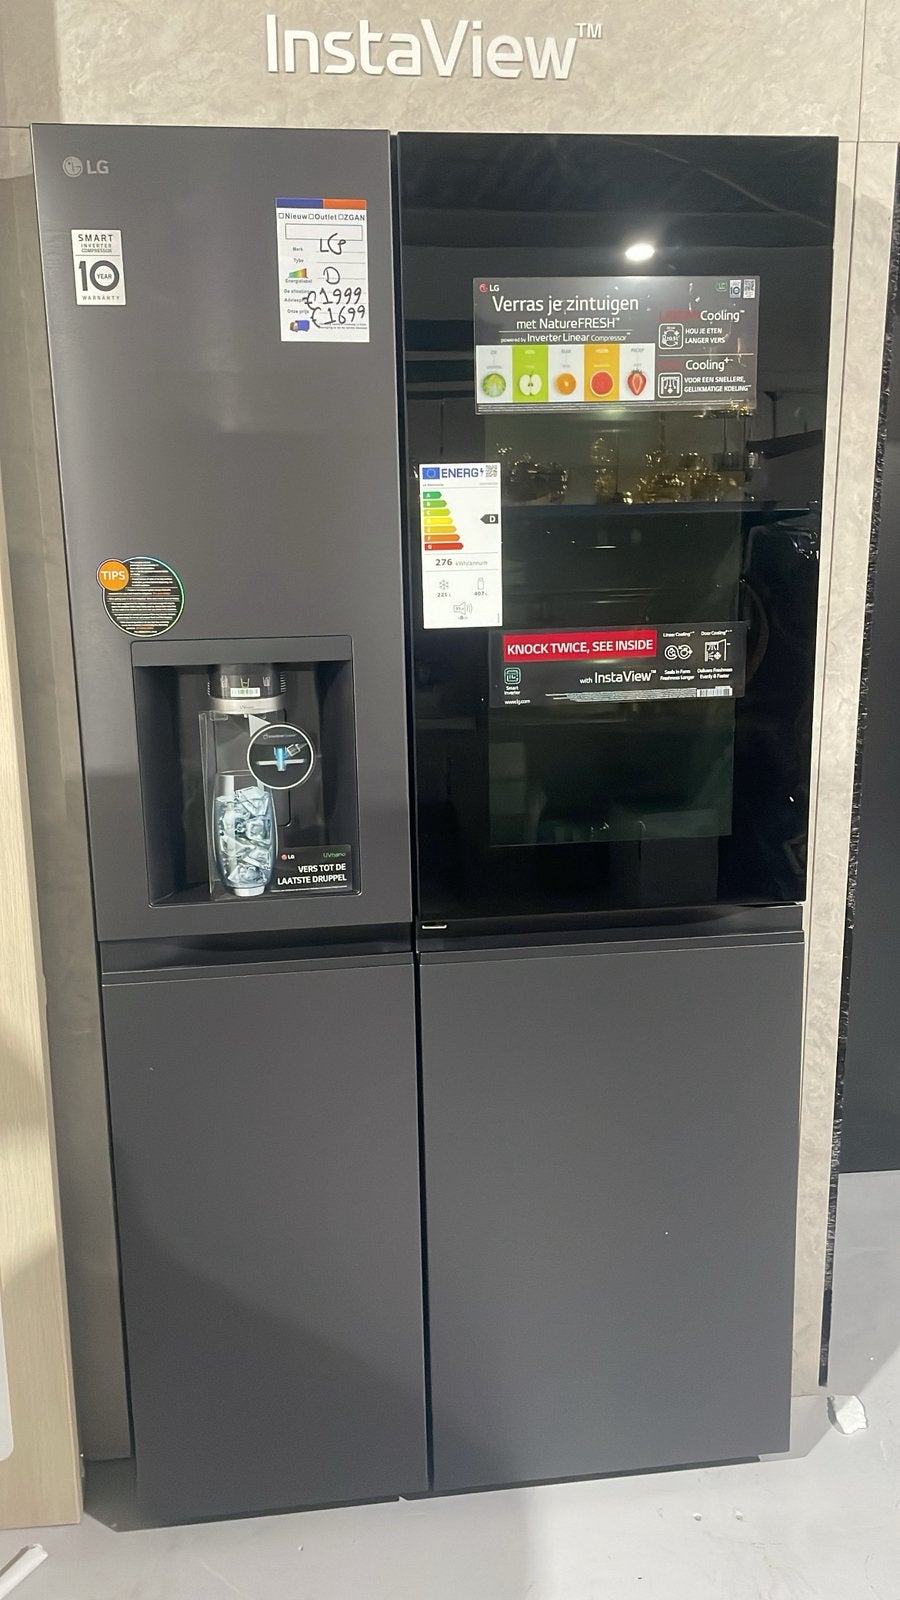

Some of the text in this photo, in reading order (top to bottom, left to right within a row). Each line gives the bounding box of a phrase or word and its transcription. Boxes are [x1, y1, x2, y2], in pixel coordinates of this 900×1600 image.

[86, 159, 109, 174] LG
[314, 213, 338, 221] Outlet
[78, 234, 114, 242] SMART
[79, 260, 119, 292] 10
[322, 266, 341, 285] D
[489, 284, 500, 292] LG
[492, 295, 544, 312] Verras
[547, 295, 562, 316] je
[566, 294, 639, 315] zintuigen
[516, 320, 537, 329] met
[527, 333, 561, 342] Inverter
[562, 333, 590, 342] Linear
[441, 468, 479, 478] ENERG
[489, 515, 497, 523] D
[435, 559, 453, 567] 276
[101, 570, 126, 580] TIPS
[507, 639, 654, 655] KNOCK TWICE, SEE INSIDE
[298, 863, 347, 873] VERS TOT DE
[277, 873, 347, 885] LAATSTE DRUPPEL
